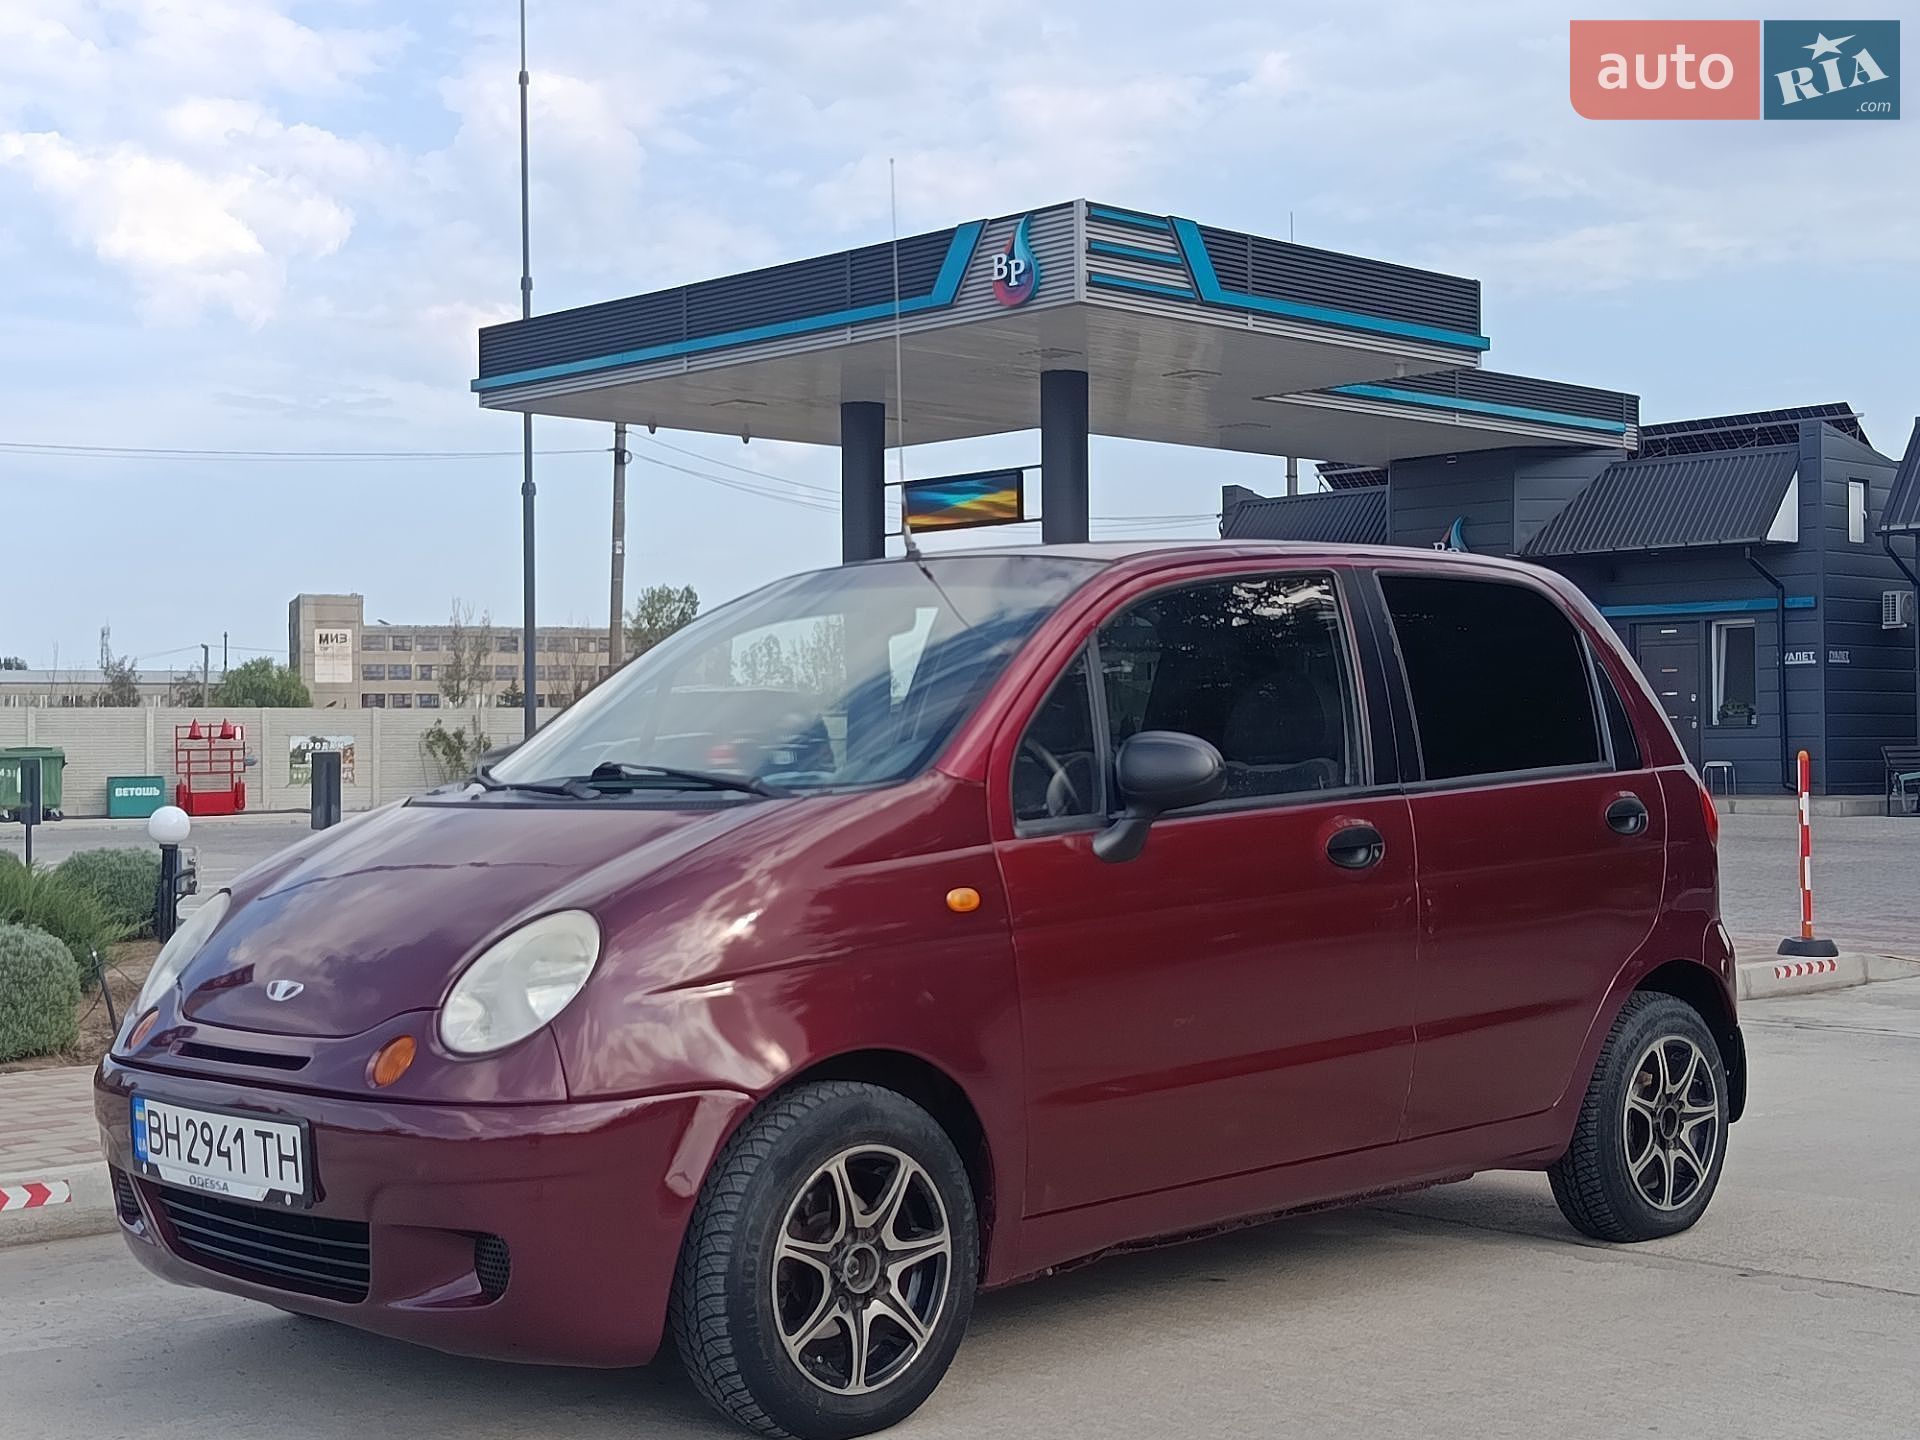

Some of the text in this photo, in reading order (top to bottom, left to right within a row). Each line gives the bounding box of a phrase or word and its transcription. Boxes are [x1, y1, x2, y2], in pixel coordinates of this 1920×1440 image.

[991, 253, 1025, 286] BP
[115, 786, 160, 797] ВЕТОШЬ
[147, 1109, 300, 1184] BH 2941 TH
[189, 1174, 229, 1192] ODESSA
